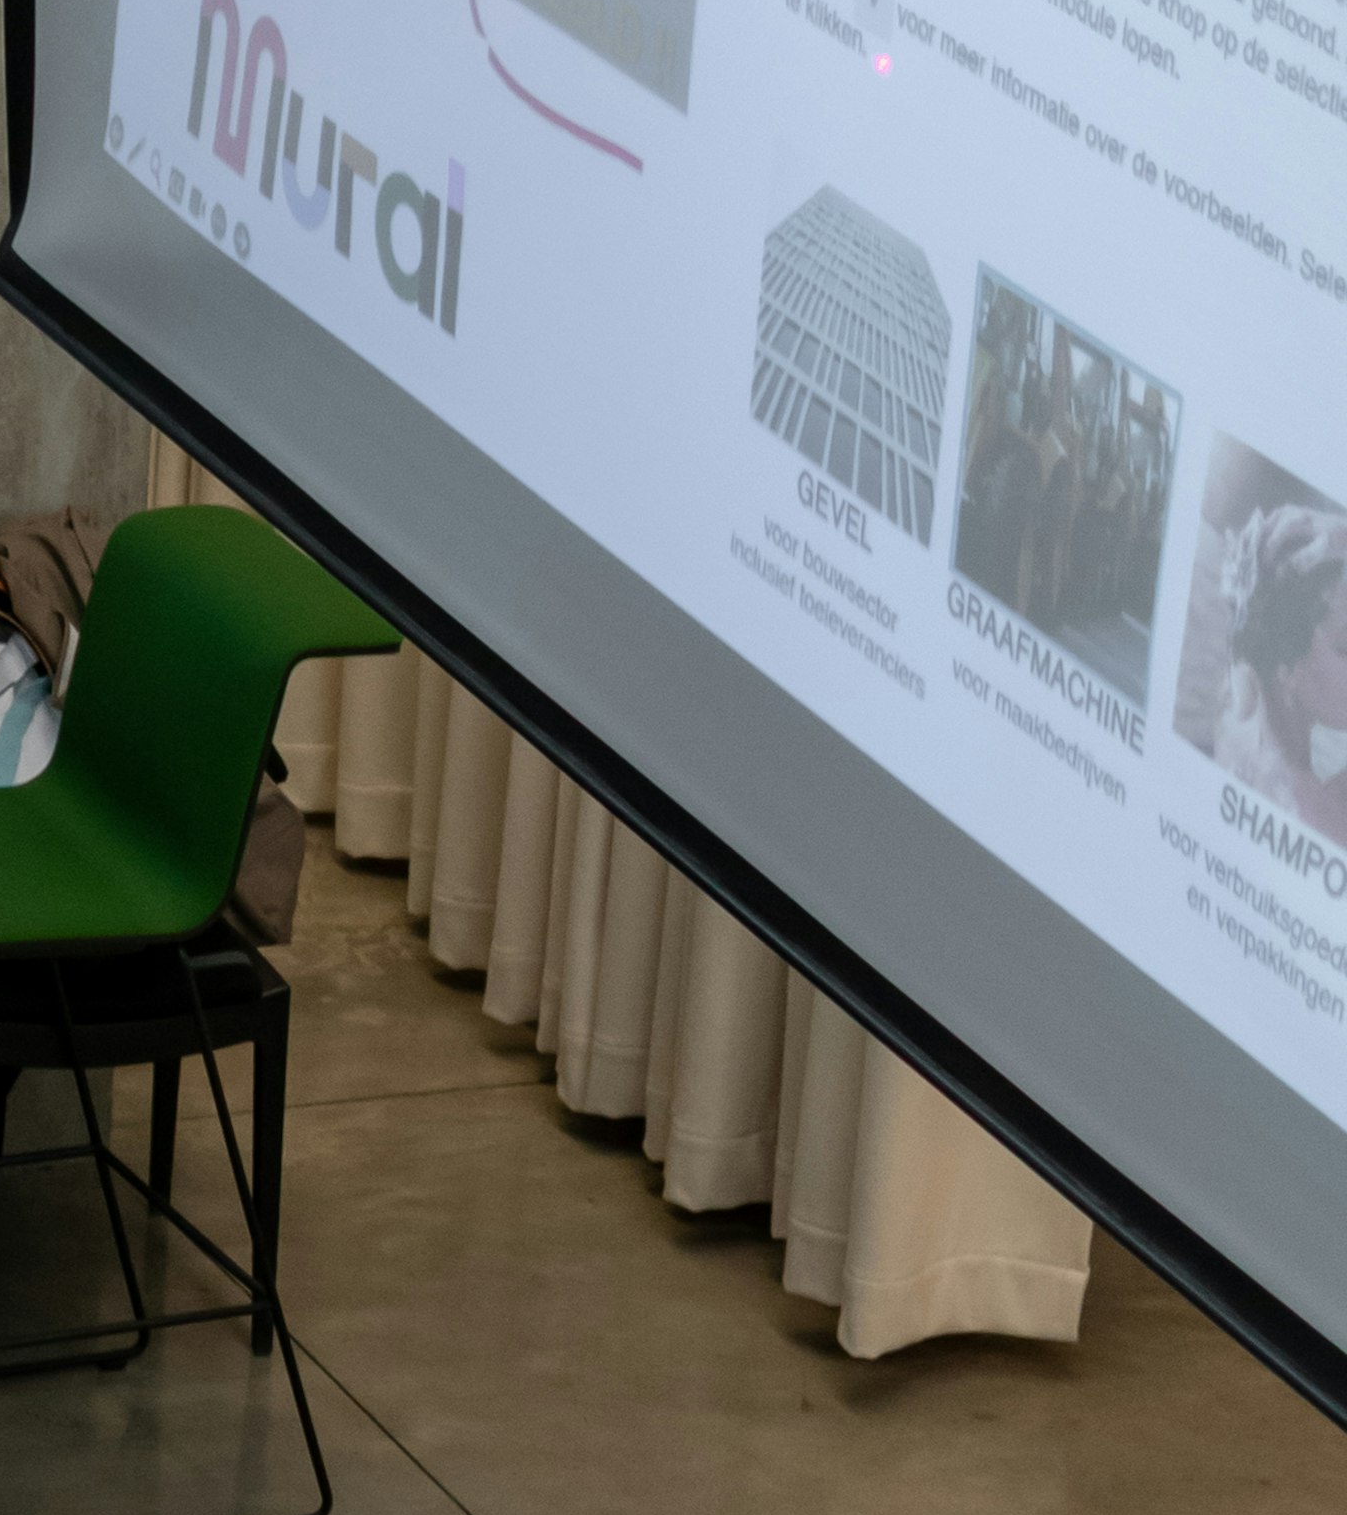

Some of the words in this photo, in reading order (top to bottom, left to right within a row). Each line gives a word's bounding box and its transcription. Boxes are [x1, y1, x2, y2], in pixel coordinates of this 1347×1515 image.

[1121, 18, 1180, 80] lopen.
[1210, 22, 1239, 59] op
[1242, 37, 1270, 74] de
[897, 4, 936, 46] voor
[939, 30, 986, 76] meer
[990, 58, 1080, 137] informatie
[1084, 123, 1128, 165] over
[1131, 150, 1158, 185] de
[1163, 169, 1291, 269] voorbeelden.
[763, 515, 800, 558] voor
[802, 539, 898, 632] bouwsector
[797, 470, 872, 554] GEVEL
[729, 531, 796, 599] inclusief
[798, 582, 925, 700] toeleveranciers
[946, 582, 1145, 757] GRAAFMACHINE
[952, 657, 991, 702] voor
[994, 689, 1126, 806] maakbedrijven
[1158, 813, 1200, 861] voor
[1204, 848, 1347, 977] verbruiksgoed
[1219, 783, 1347, 898] SHAMPO
[1186, 884, 1210, 920] en
[1215, 905, 1344, 1022] verpakkingen
